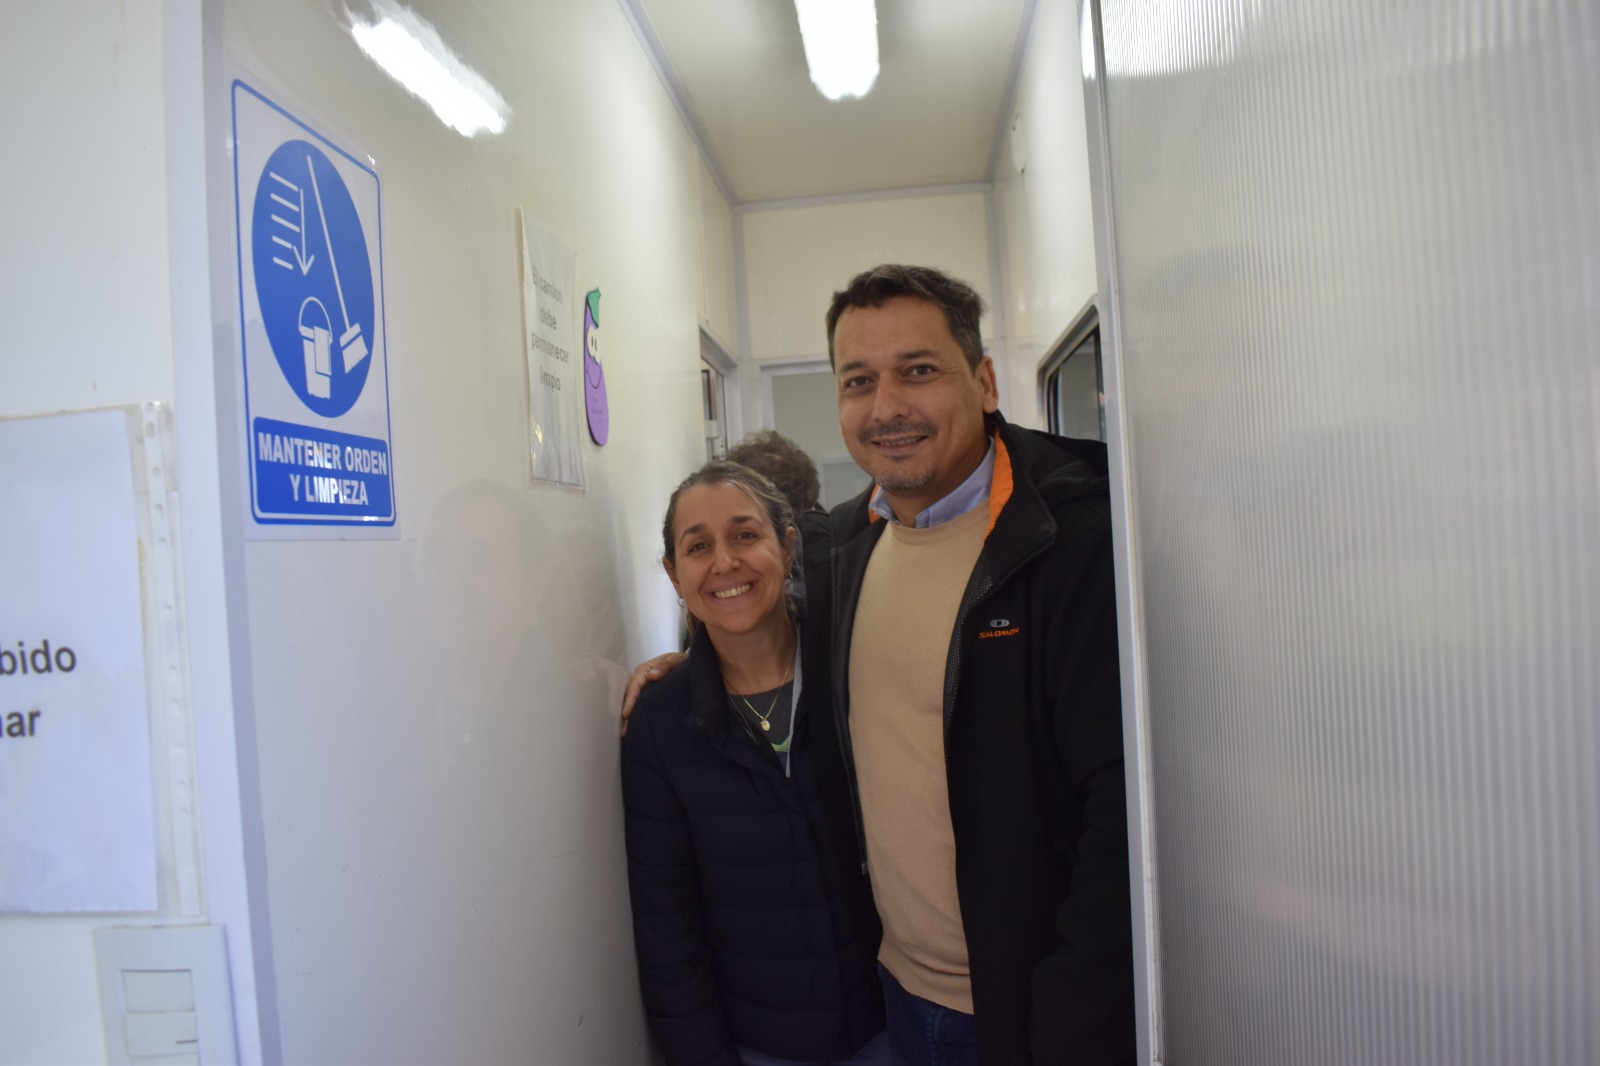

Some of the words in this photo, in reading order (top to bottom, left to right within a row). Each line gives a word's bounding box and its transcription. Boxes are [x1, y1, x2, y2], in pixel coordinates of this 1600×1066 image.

[540, 305, 557, 330] debe
[531, 332, 570, 364] permanecer
[540, 366, 562, 392] limpio
[258, 432, 342, 470] MANTENER
[345, 446, 388, 475] ORDEN
[289, 474, 301, 502] Y
[305, 475, 369, 506] LIMPIEZA
[978, 627, 1020, 639] SALOMON
[0, 639, 77, 676] bido
[0, 710, 41, 738] ar
